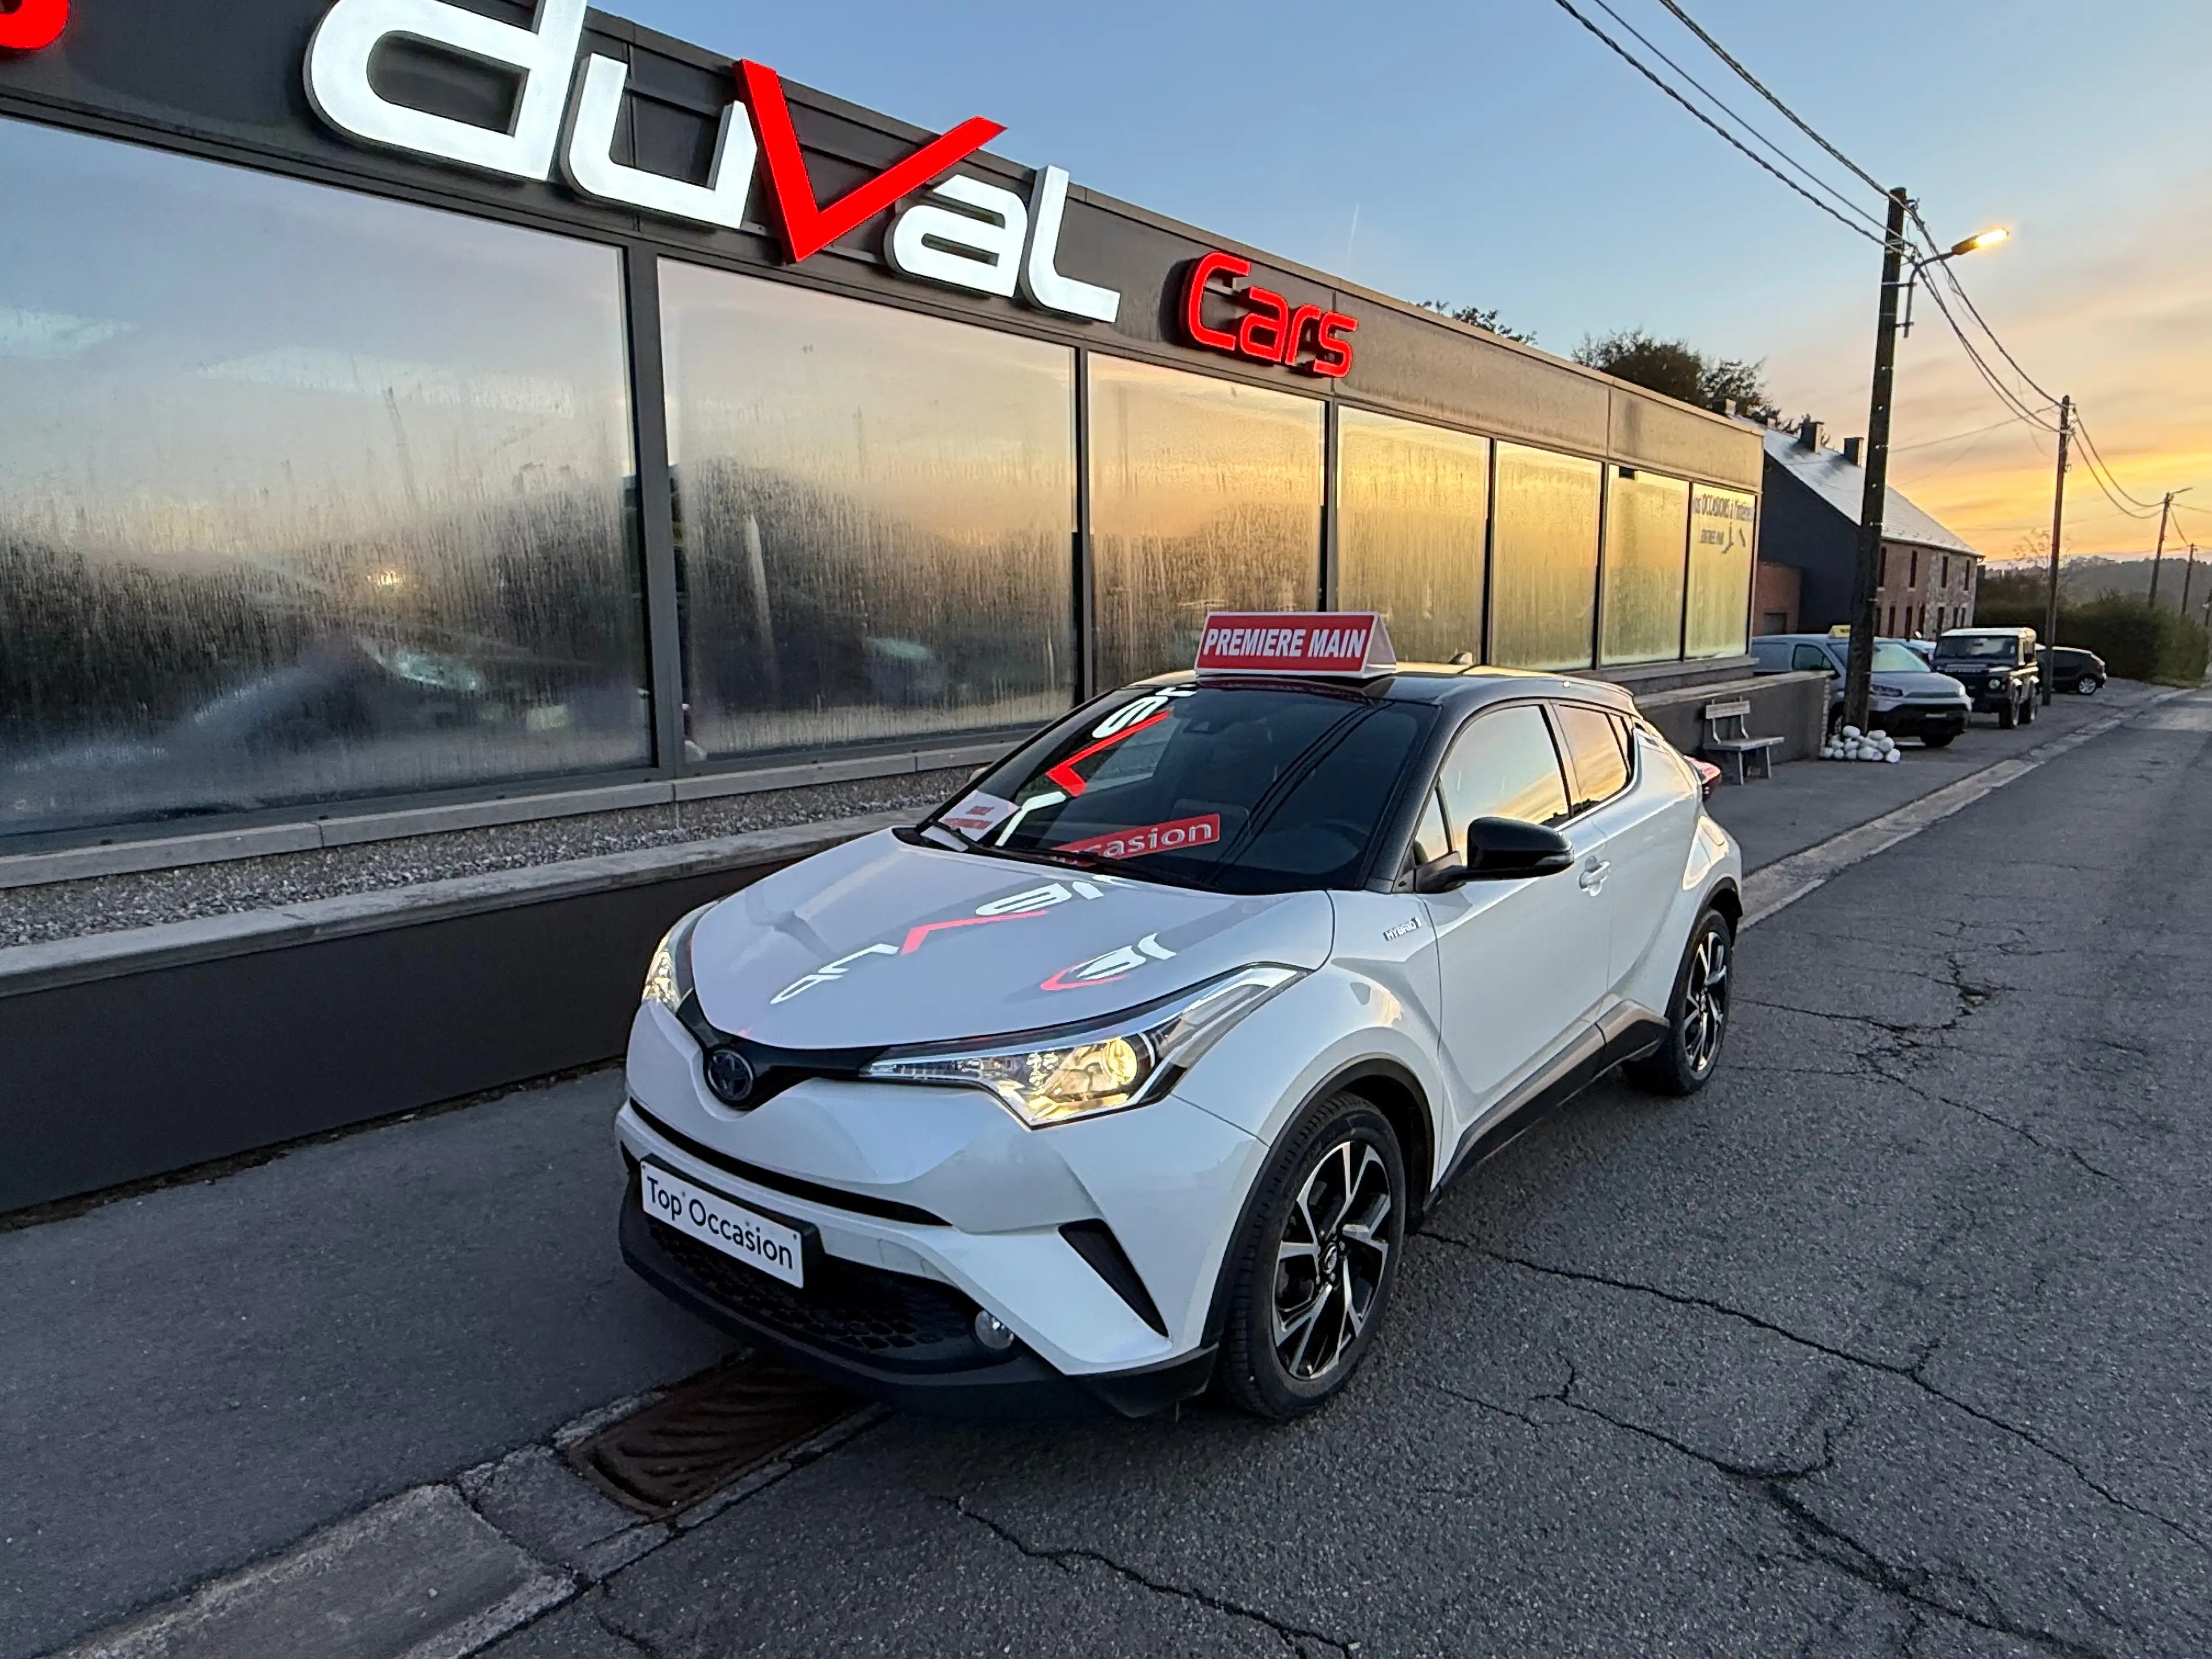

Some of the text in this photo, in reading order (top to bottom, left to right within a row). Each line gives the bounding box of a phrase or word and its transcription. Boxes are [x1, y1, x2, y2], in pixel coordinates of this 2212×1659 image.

[1188, 251, 1358, 378] Cars
[1203, 628, 1367, 658] PREMIERE MAIN
[1078, 823, 1212, 858] asion
[1384, 921, 1416, 941] HYBRID
[646, 1175, 793, 1270] Top Occasion
